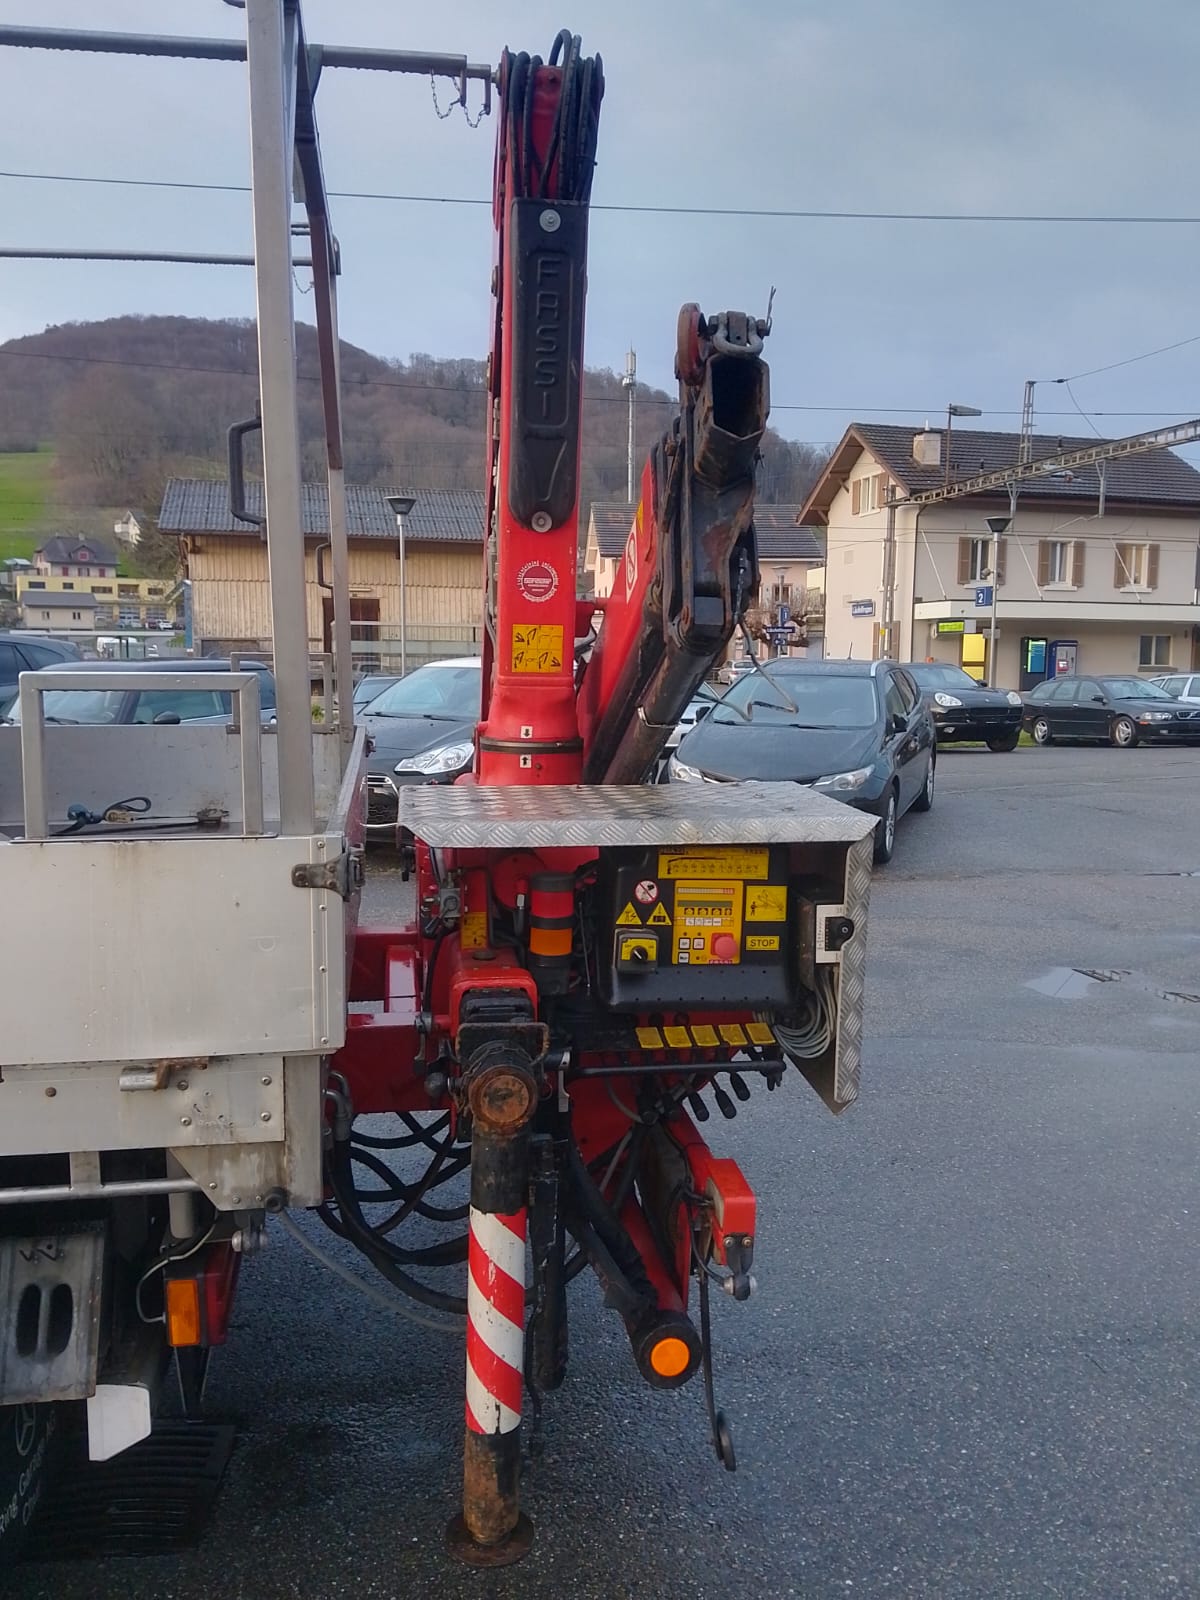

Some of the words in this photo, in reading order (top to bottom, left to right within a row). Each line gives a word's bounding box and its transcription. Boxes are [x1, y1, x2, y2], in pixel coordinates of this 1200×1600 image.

[534, 257, 560, 417] FASSI
[978, 592, 984, 603] 2
[750, 938, 775, 947] STOP
